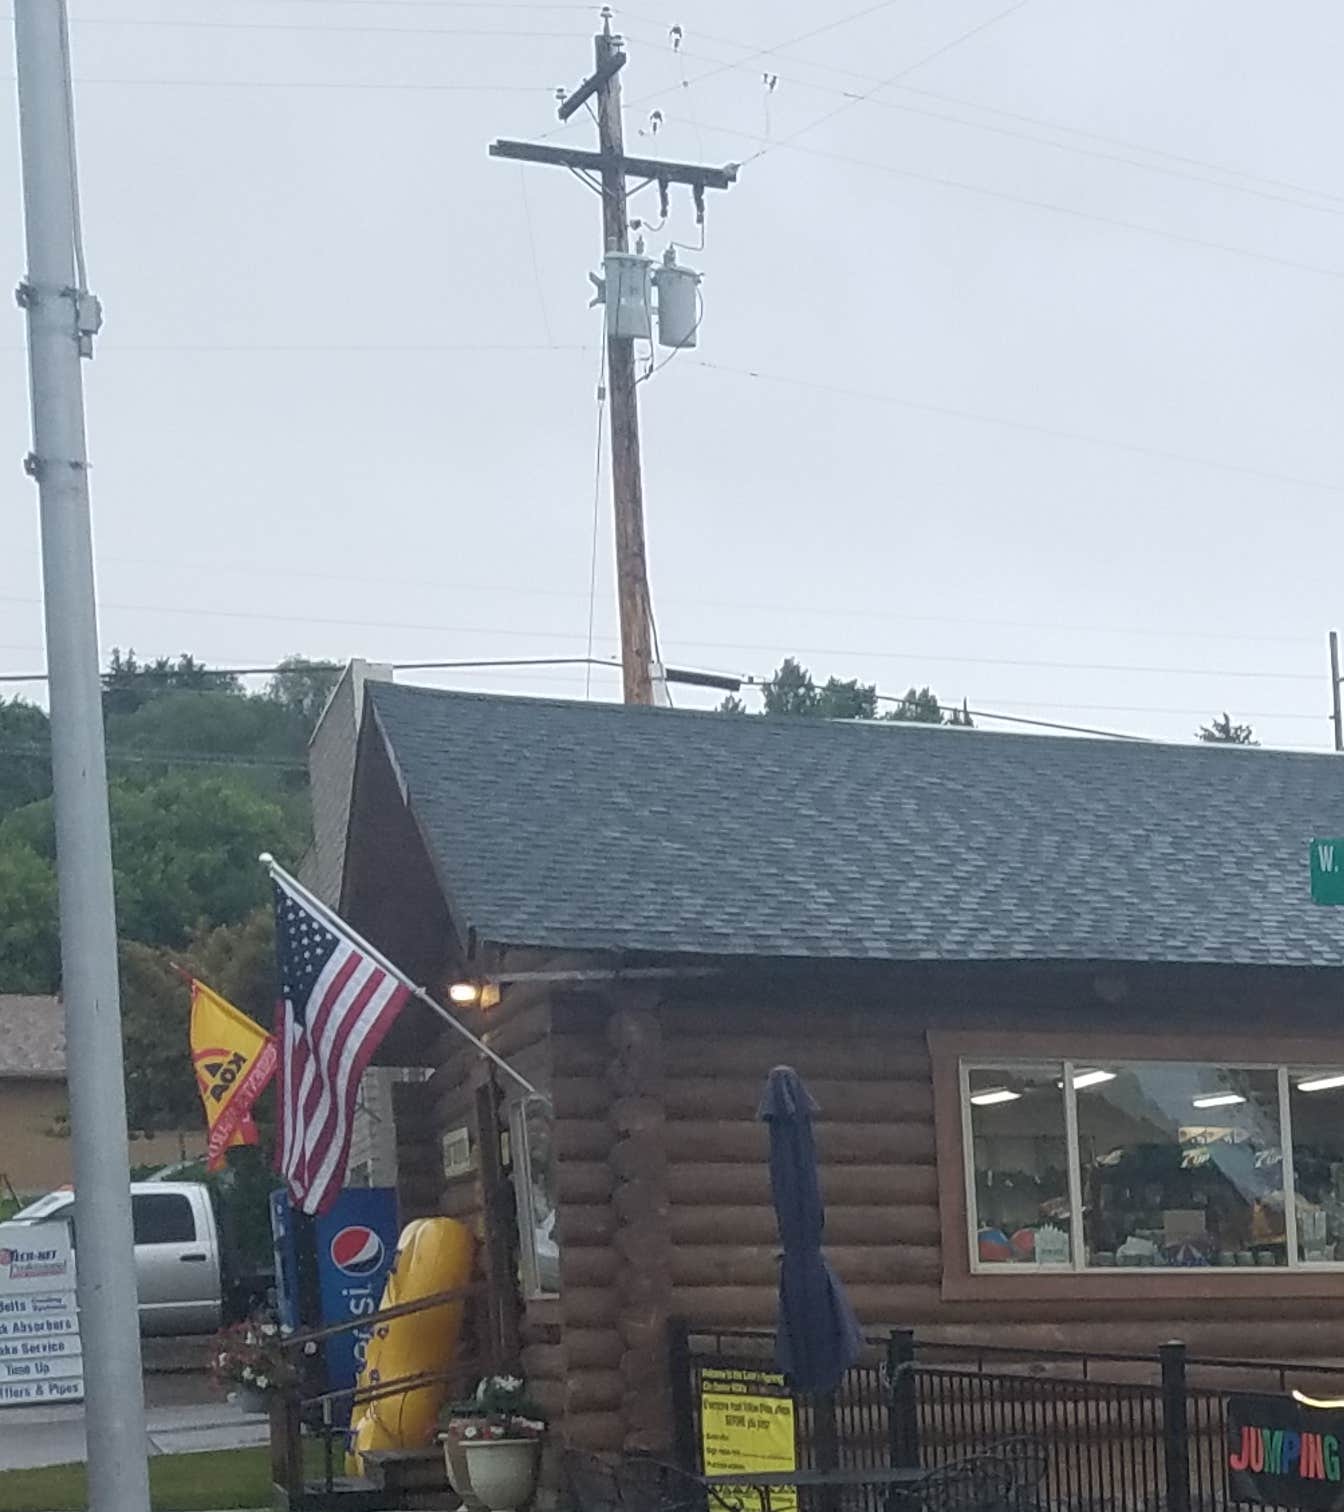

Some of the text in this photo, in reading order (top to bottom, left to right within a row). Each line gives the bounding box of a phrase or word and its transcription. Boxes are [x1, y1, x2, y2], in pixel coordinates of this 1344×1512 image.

[1318, 845, 1339, 873] W.
[21, 1341, 65, 1354] Service
[35, 1361, 50, 1375] Up
[49, 1381, 79, 1397] Pipes
[1230, 1426, 1341, 1481] JUMPING
